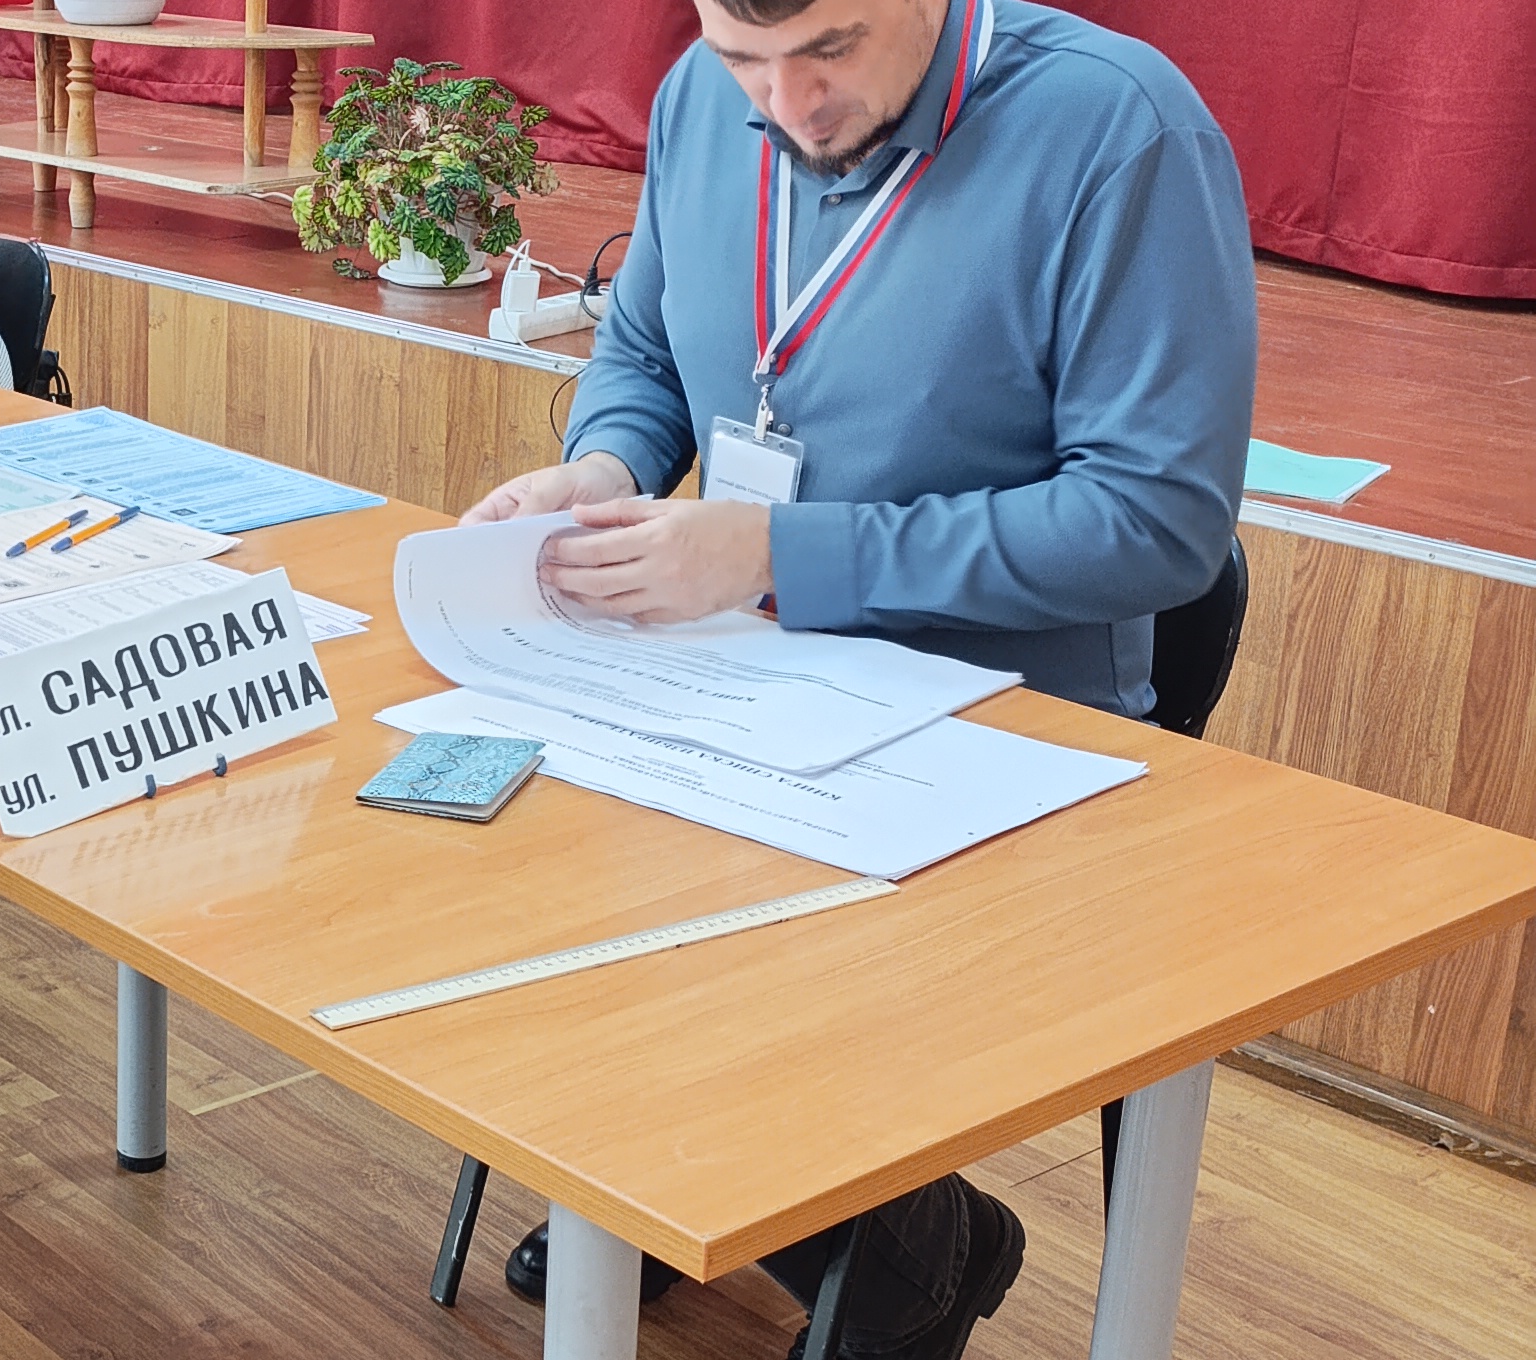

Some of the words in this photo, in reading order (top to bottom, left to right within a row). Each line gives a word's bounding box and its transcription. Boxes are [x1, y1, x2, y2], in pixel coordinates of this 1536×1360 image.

[40, 598, 288, 716] САДОВАЯ
[0, 772, 57, 815] ул.
[66, 661, 329, 790] ПУШКИНА
[698, 752, 774, 778] СПИСКА
[777, 776, 843, 802] КНИГА
